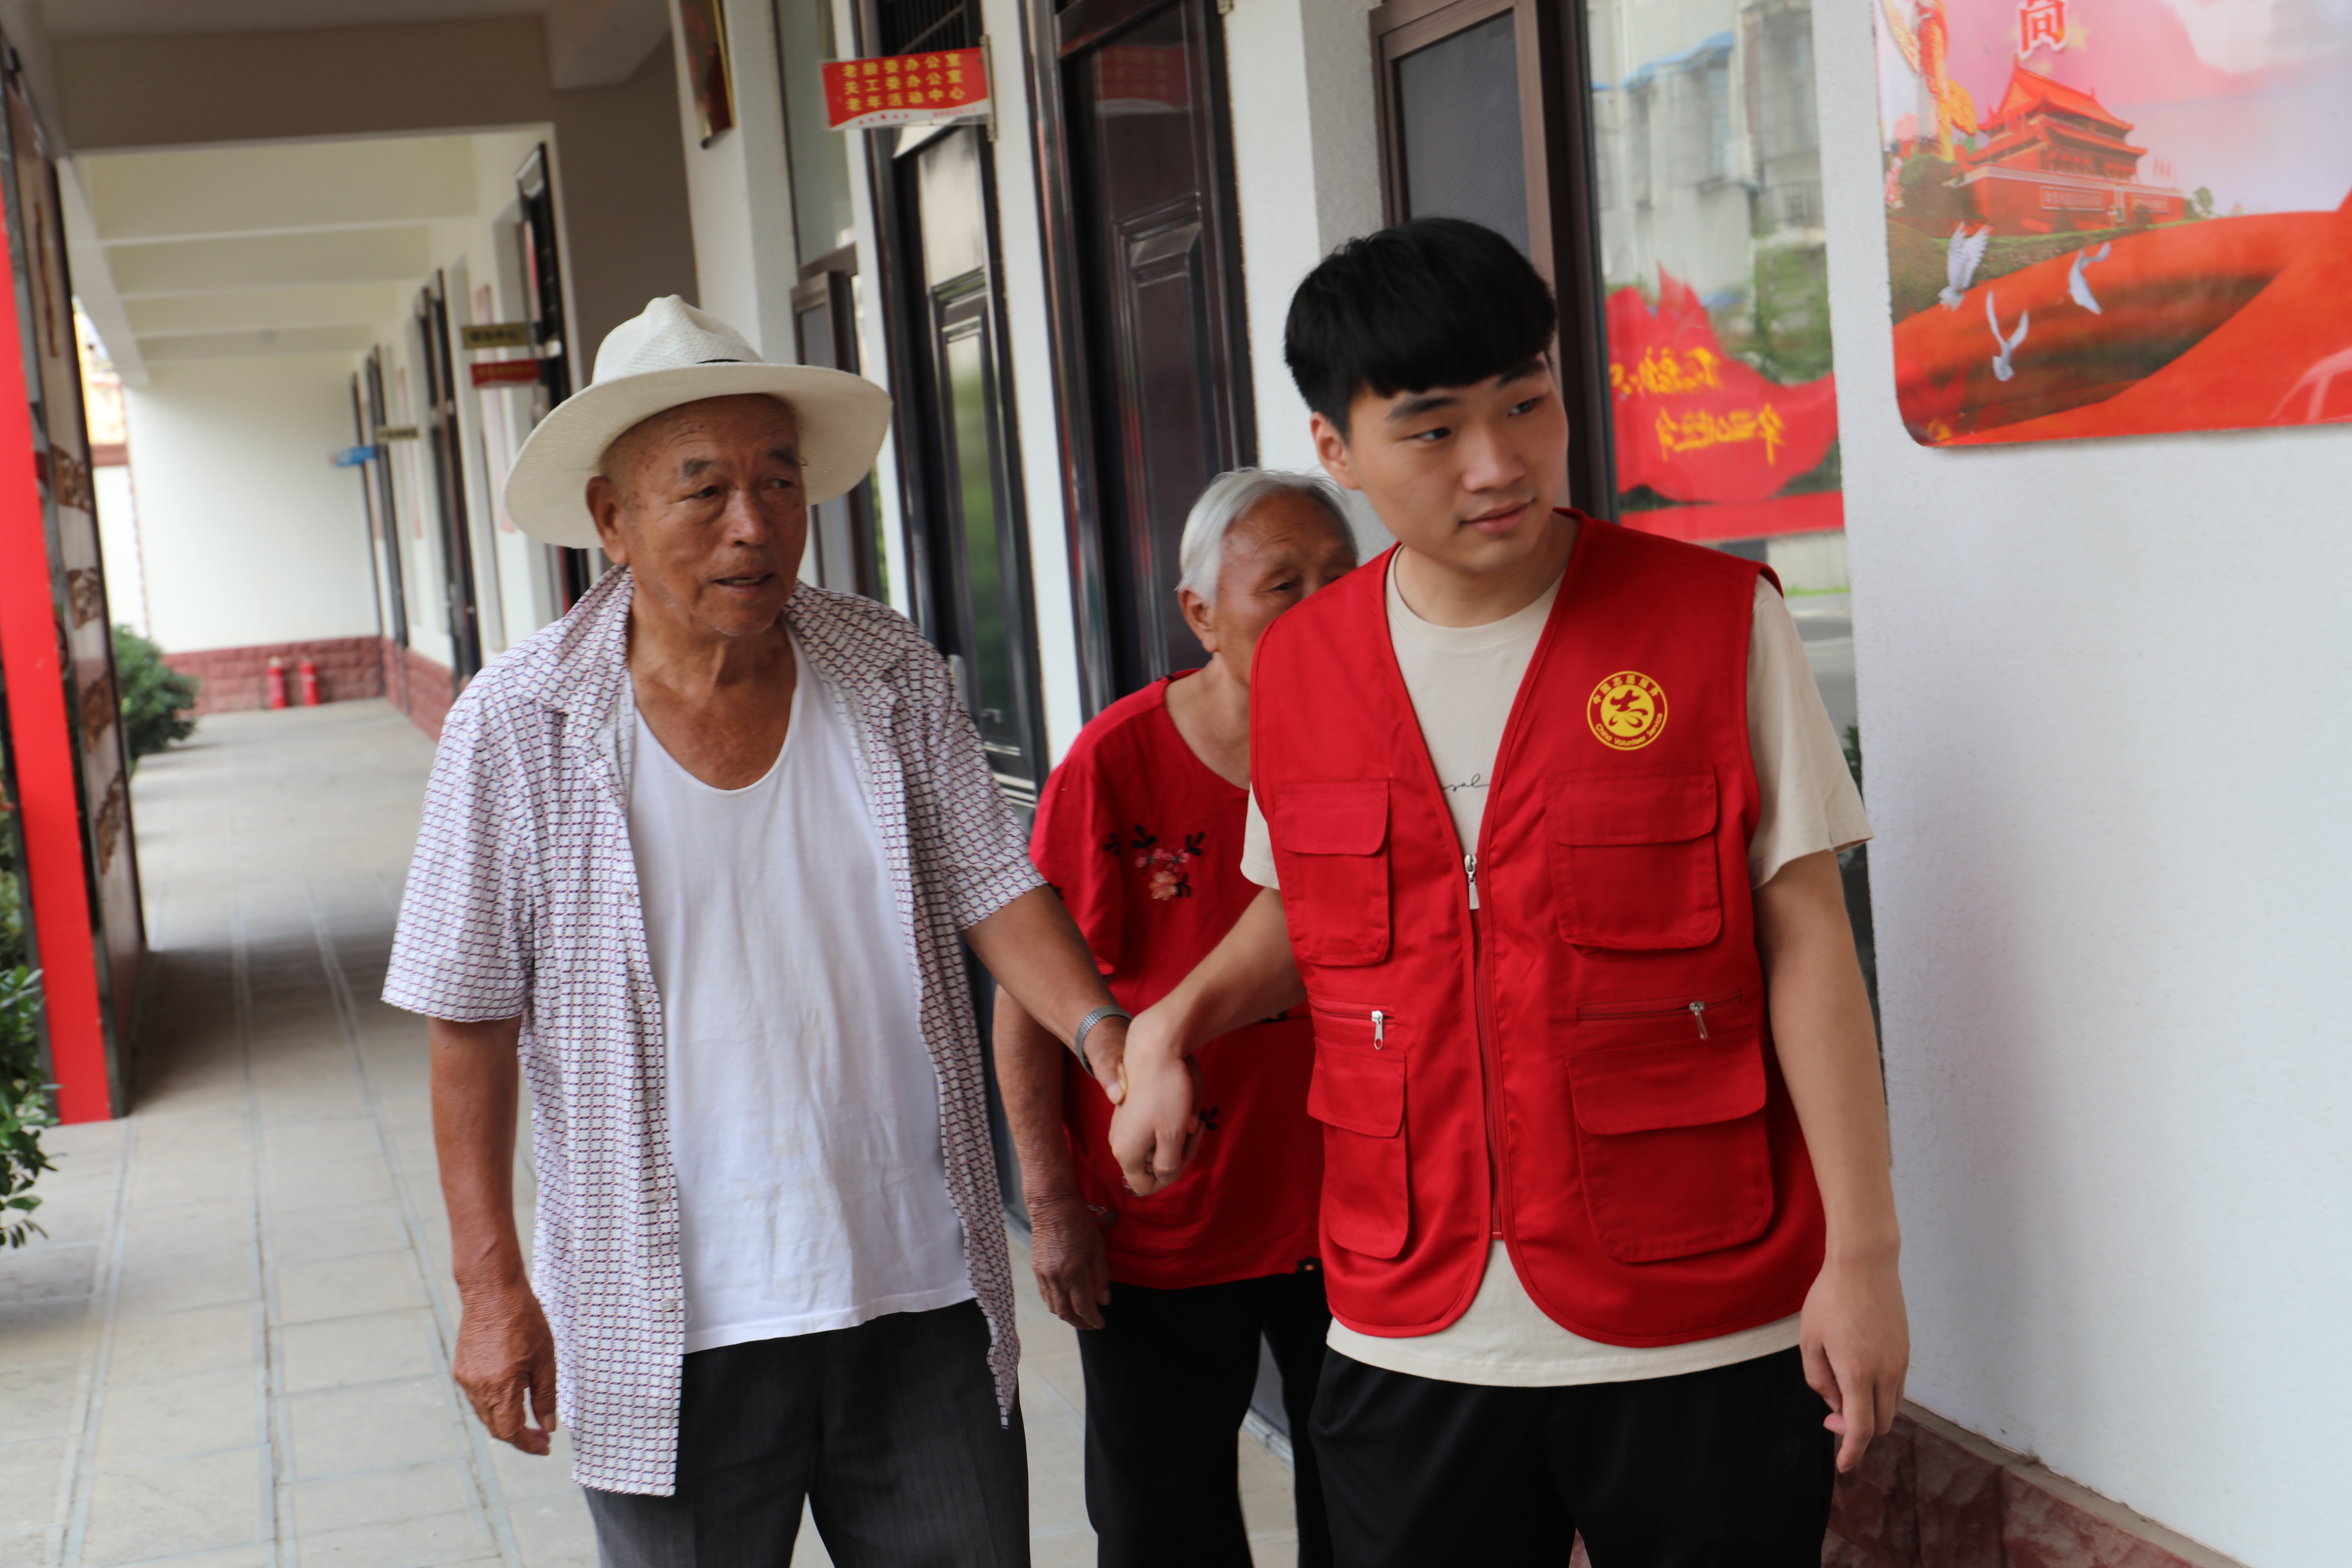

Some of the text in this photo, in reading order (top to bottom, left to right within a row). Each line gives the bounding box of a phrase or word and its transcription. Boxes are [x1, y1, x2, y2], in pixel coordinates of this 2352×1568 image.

[846, 87, 965, 111] 老年活动中心
